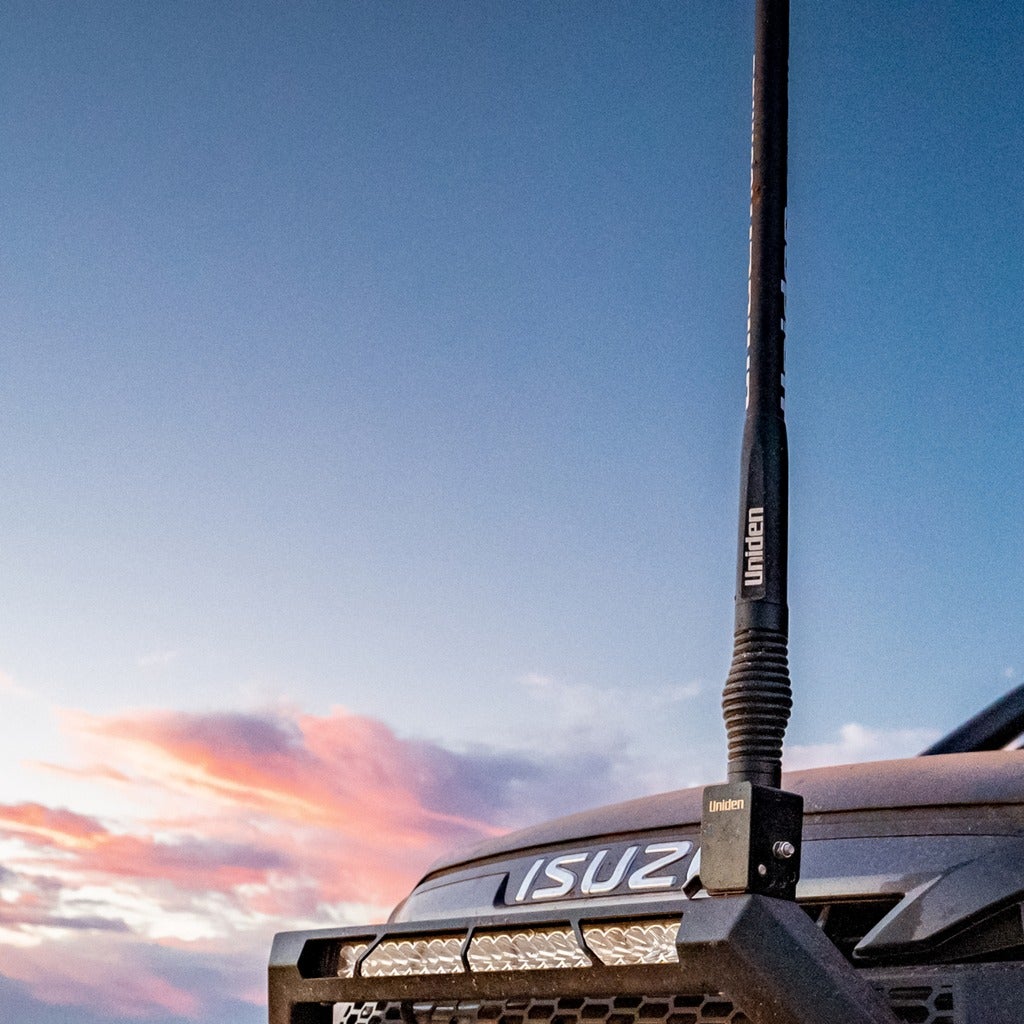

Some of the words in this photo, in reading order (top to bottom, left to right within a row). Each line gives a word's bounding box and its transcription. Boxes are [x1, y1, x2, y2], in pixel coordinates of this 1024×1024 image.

[744, 507, 764, 586] Uniden
[709, 798, 744, 812] Uniden
[515, 840, 702, 901] ISUZ
